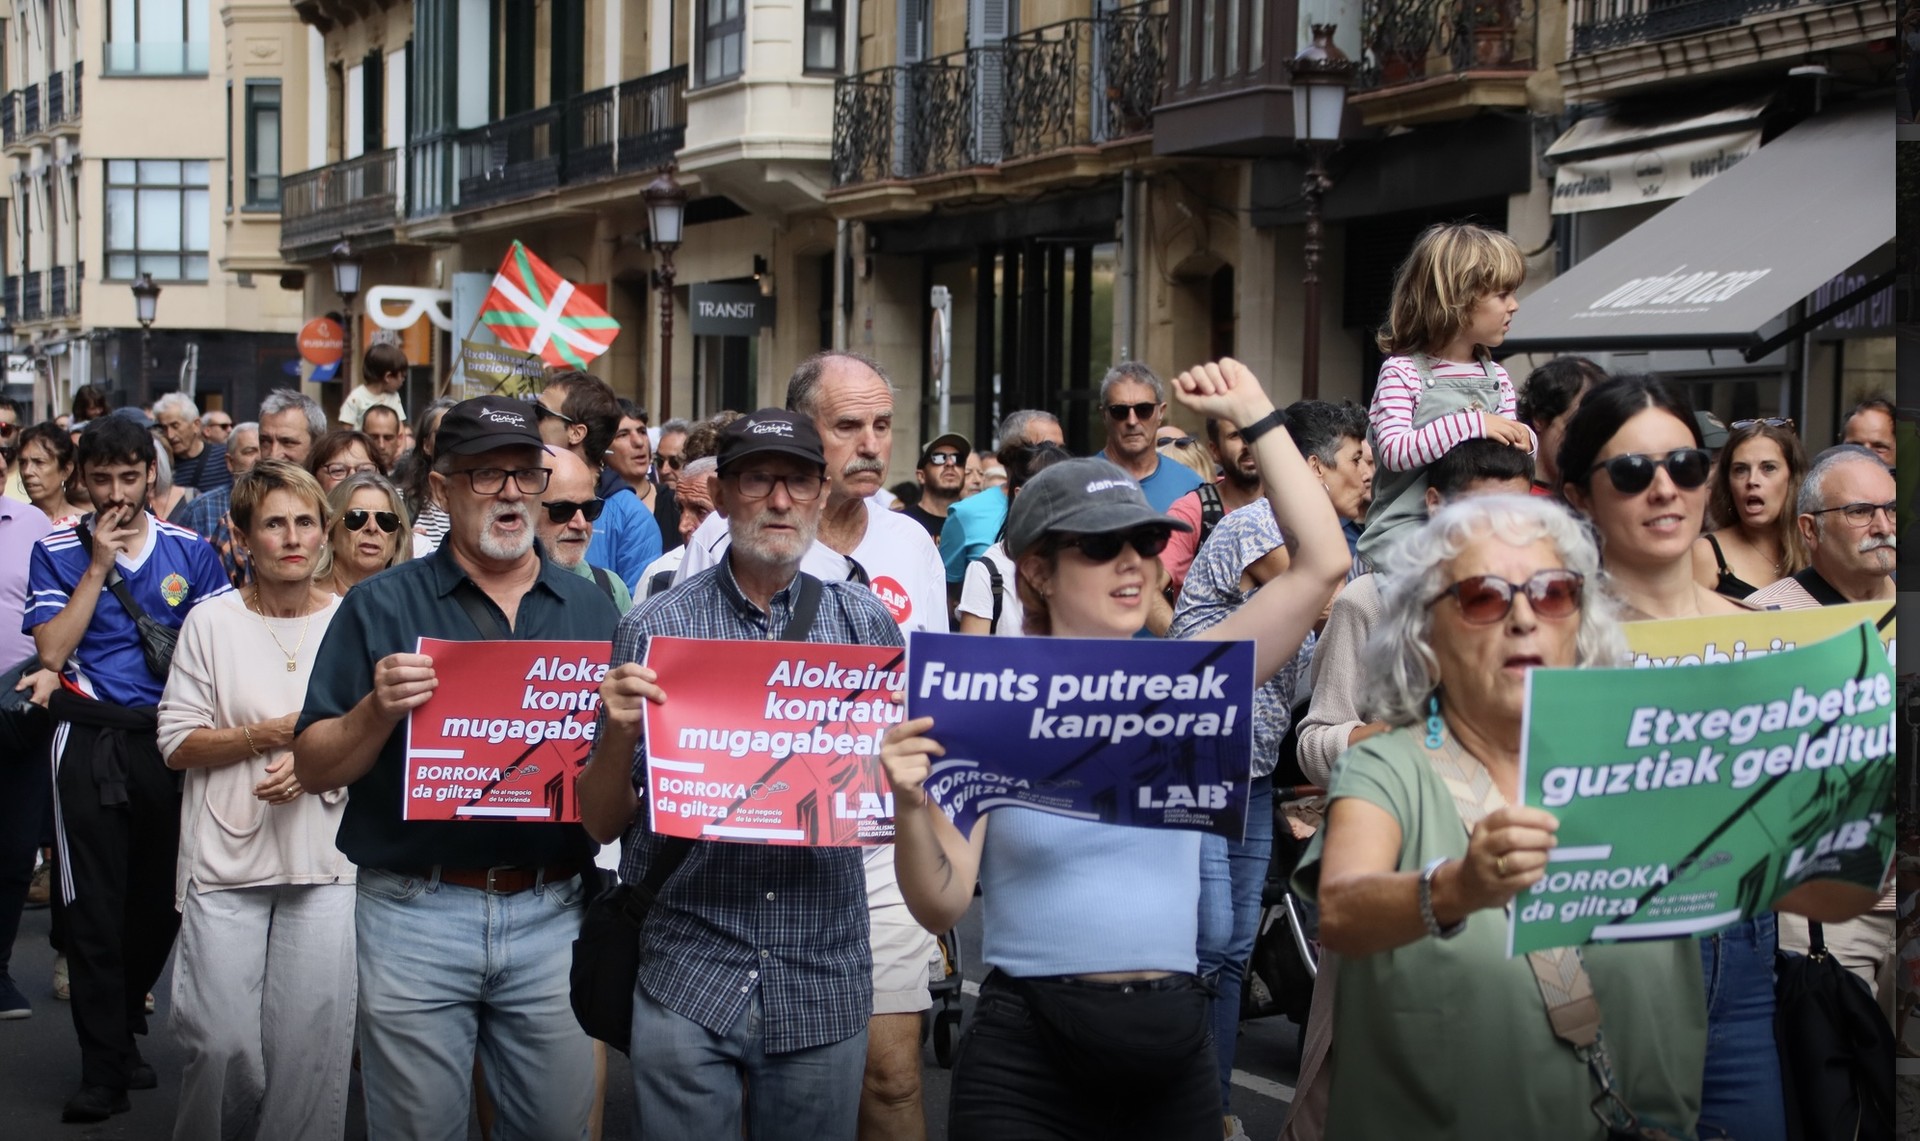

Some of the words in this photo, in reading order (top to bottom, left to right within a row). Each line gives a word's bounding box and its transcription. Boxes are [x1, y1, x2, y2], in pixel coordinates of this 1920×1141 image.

[699, 302, 756, 318] TRANSIT
[468, 362, 510, 375] prezioa
[872, 582, 908, 610] LAB
[765, 660, 906, 691] Alokairu
[919, 661, 1040, 701] Funts
[1047, 665, 1230, 709] putreak
[522, 685, 604, 711] kontr
[764, 691, 904, 724] kontratu
[1626, 672, 1892, 748] Etxegabetze
[441, 716, 596, 745] mugagabe
[1029, 705, 1238, 744] kanpora!
[416, 766, 500, 781] BORROKA
[1542, 746, 1727, 807] guztiak
[412, 784, 432, 798] da
[436, 785, 482, 802] giltza
[506, 790, 532, 798] negocio
[659, 778, 747, 800] BORROKA
[930, 771, 1030, 804] BORROKA
[953, 784, 1008, 814] giltza
[1138, 783, 1230, 810] LAB
[657, 797, 676, 813] da
[681, 799, 728, 819] giltza
[755, 809, 783, 818] negocio
[1530, 863, 1669, 895] BORROKA
[1521, 900, 1554, 923] da
[1560, 896, 1638, 923] giltza
